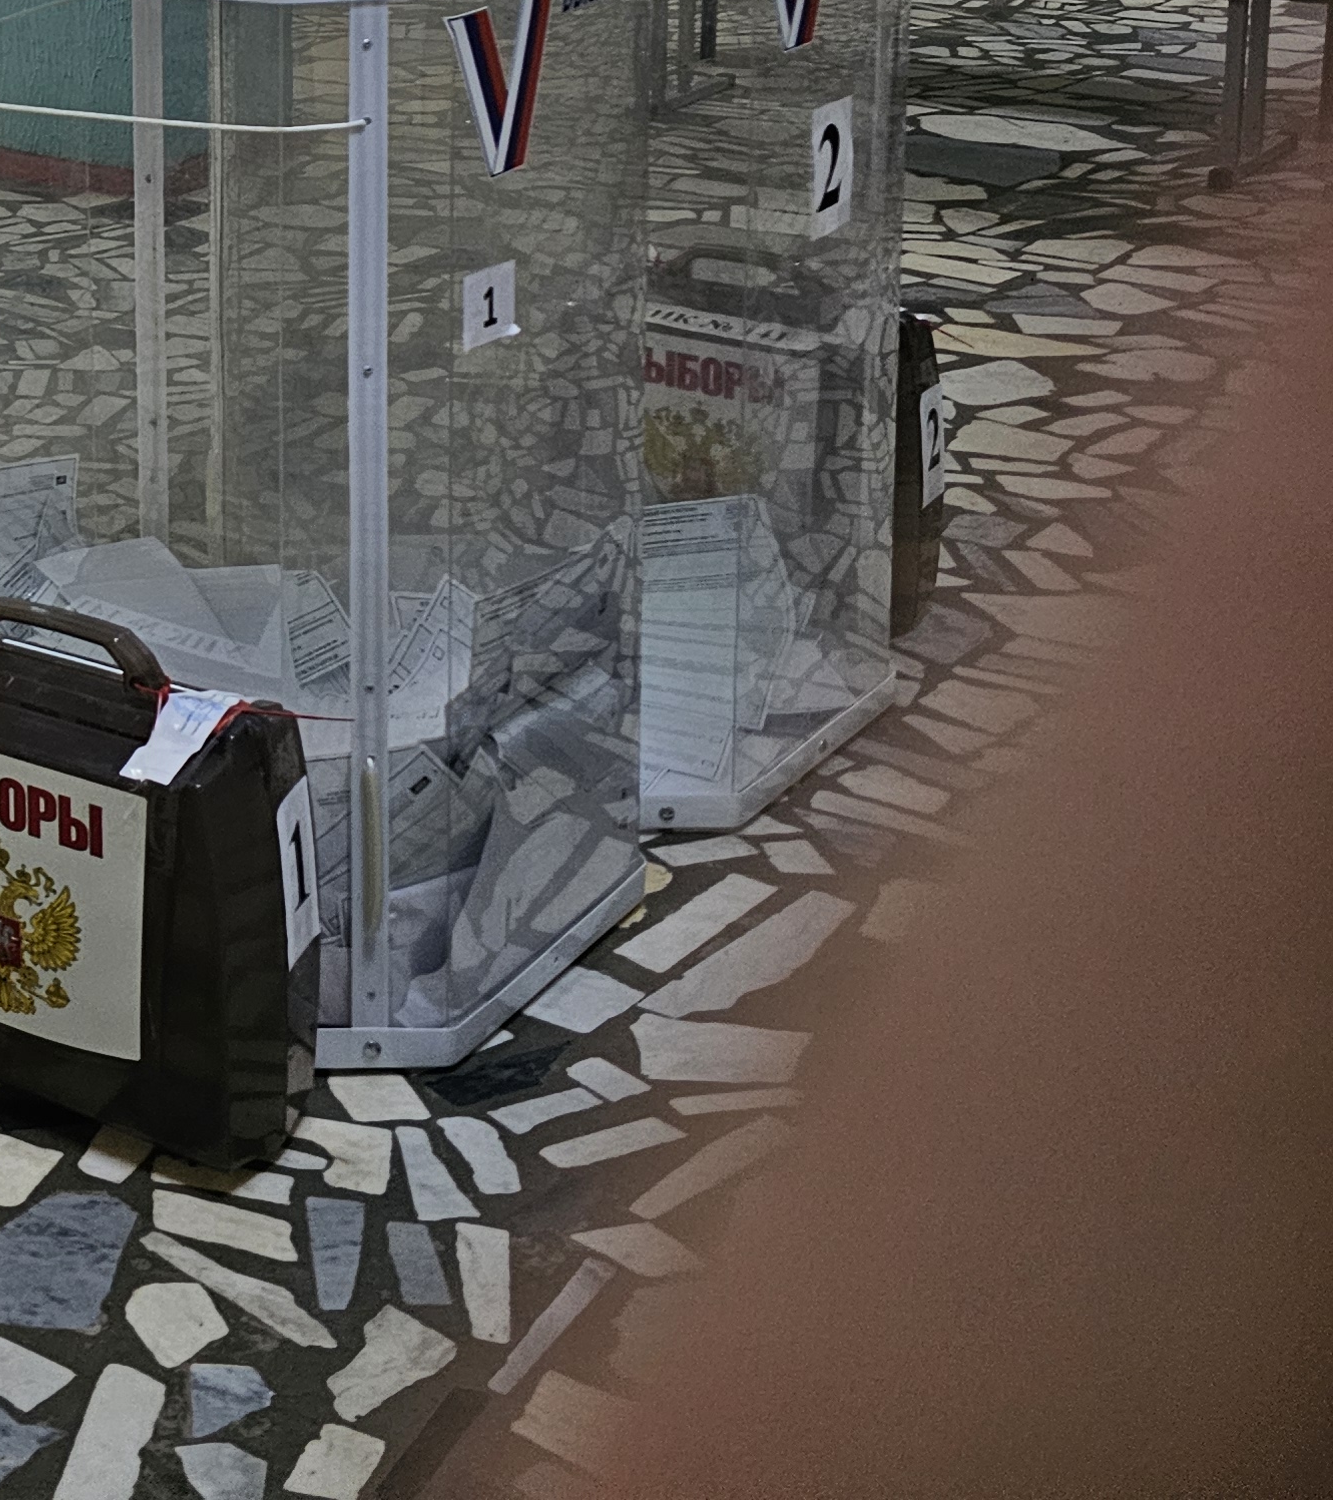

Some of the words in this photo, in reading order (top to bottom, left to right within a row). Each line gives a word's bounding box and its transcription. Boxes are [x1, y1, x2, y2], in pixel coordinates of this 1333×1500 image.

[816, 123, 843, 213] 2
[482, 285, 498, 328] 1
[927, 407, 940, 472] 2
[286, 818, 307, 912] 1
